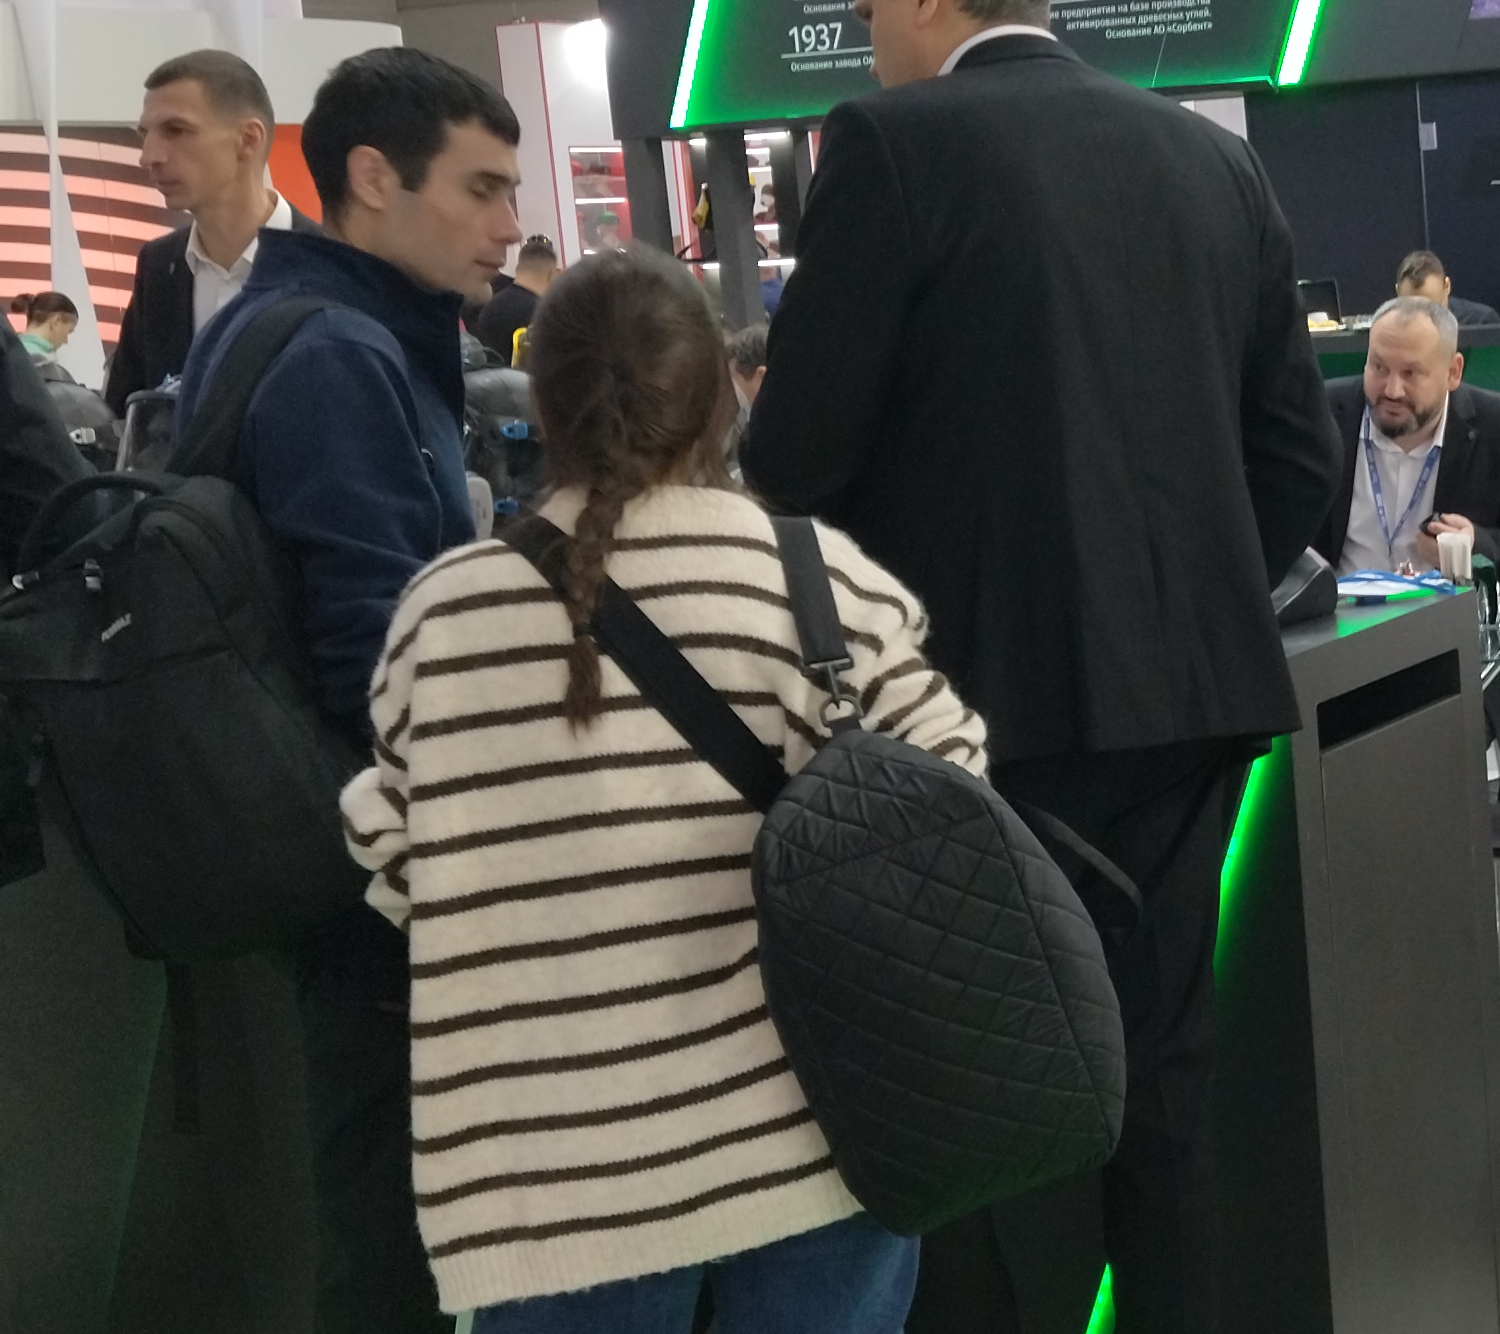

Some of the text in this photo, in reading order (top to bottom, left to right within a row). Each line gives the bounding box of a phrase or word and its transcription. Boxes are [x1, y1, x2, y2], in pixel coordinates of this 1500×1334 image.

[1061, 5, 1116, 20] предприятия
[1130, 0, 1149, 12] базе
[1137, 11, 1184, 25] древесных
[788, 22, 842, 53] 1937
[1105, 26, 1151, 39] Основание
[1153, 24, 1166, 34] АО
